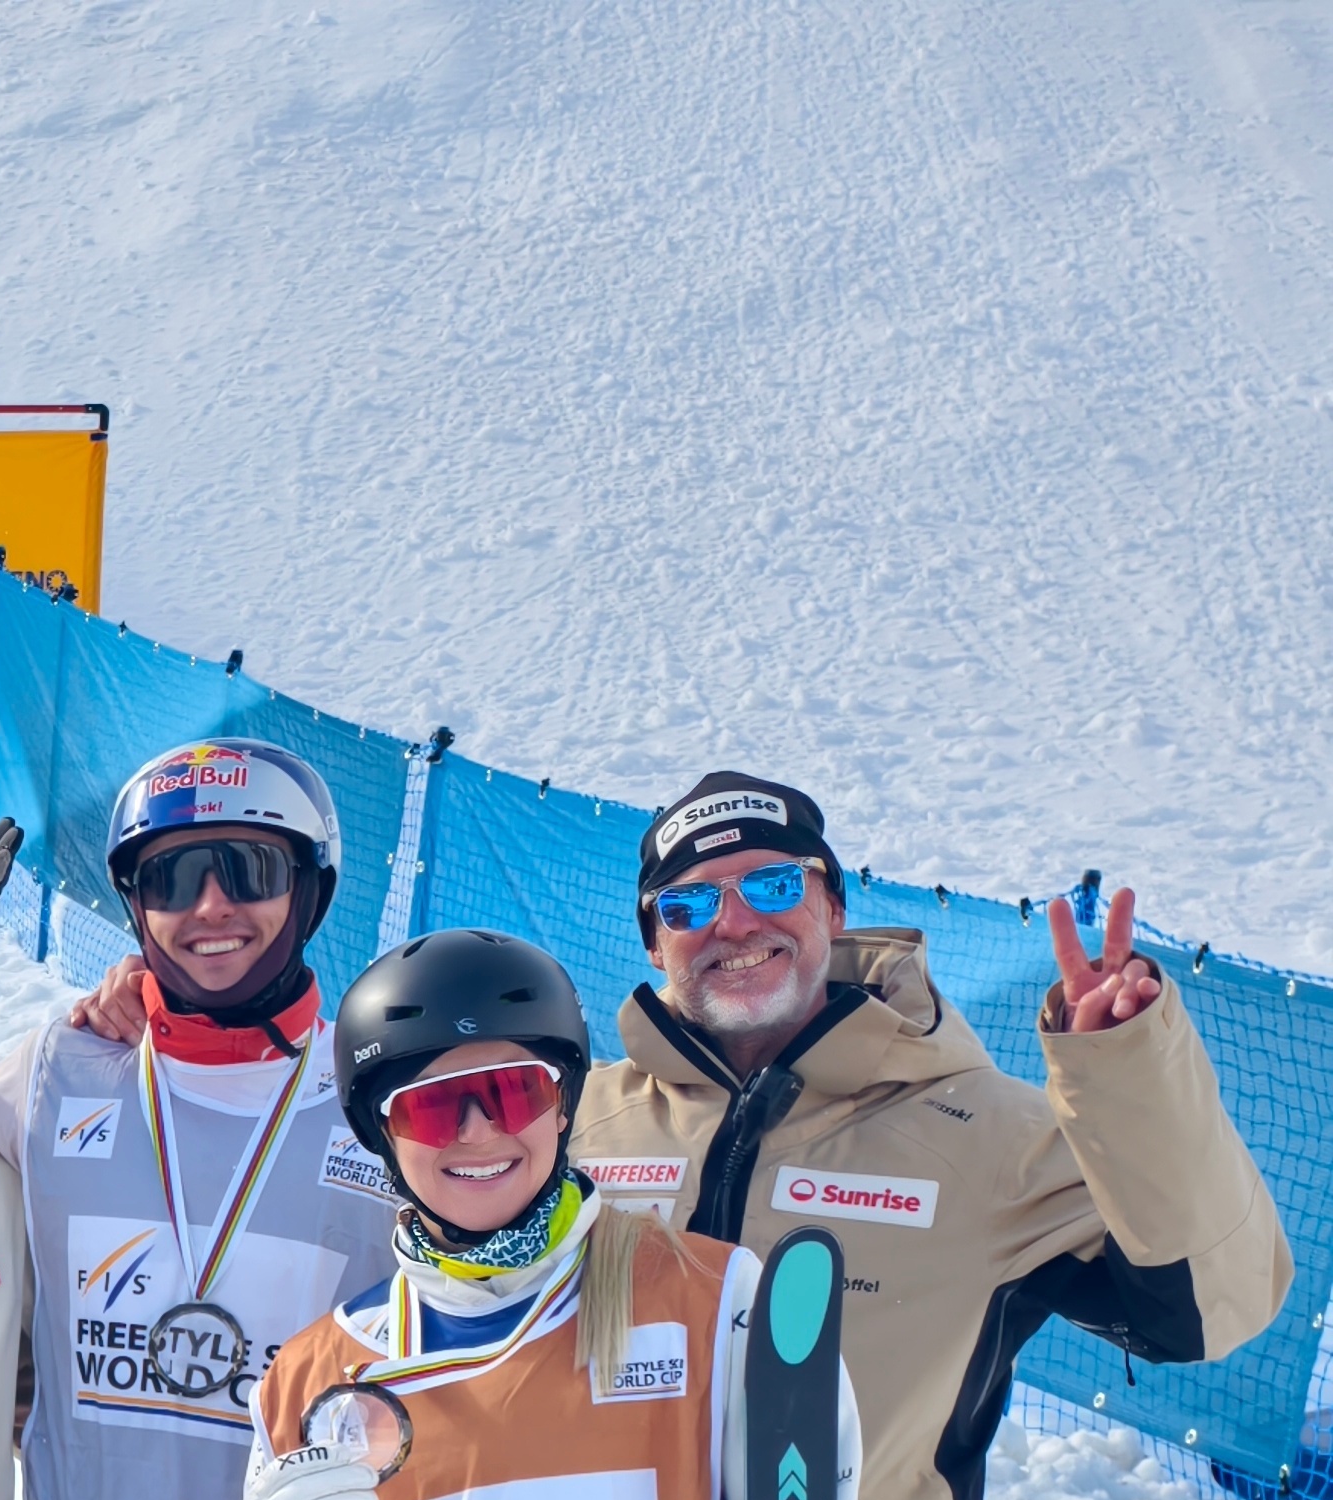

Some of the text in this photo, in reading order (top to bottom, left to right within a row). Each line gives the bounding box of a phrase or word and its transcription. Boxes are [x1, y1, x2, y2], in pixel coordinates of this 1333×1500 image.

[150, 764, 248, 796] Red Bull
[684, 795, 780, 826] Sunrise
[354, 1042, 381, 1064] bern
[59, 1127, 111, 1143] FIS
[325, 1164, 378, 1188] WORLD
[327, 1154, 387, 1180] FREESTYL
[821, 1184, 922, 1213] Sunrise
[78, 1269, 151, 1295] FIS
[613, 1371, 657, 1389] ORLD
